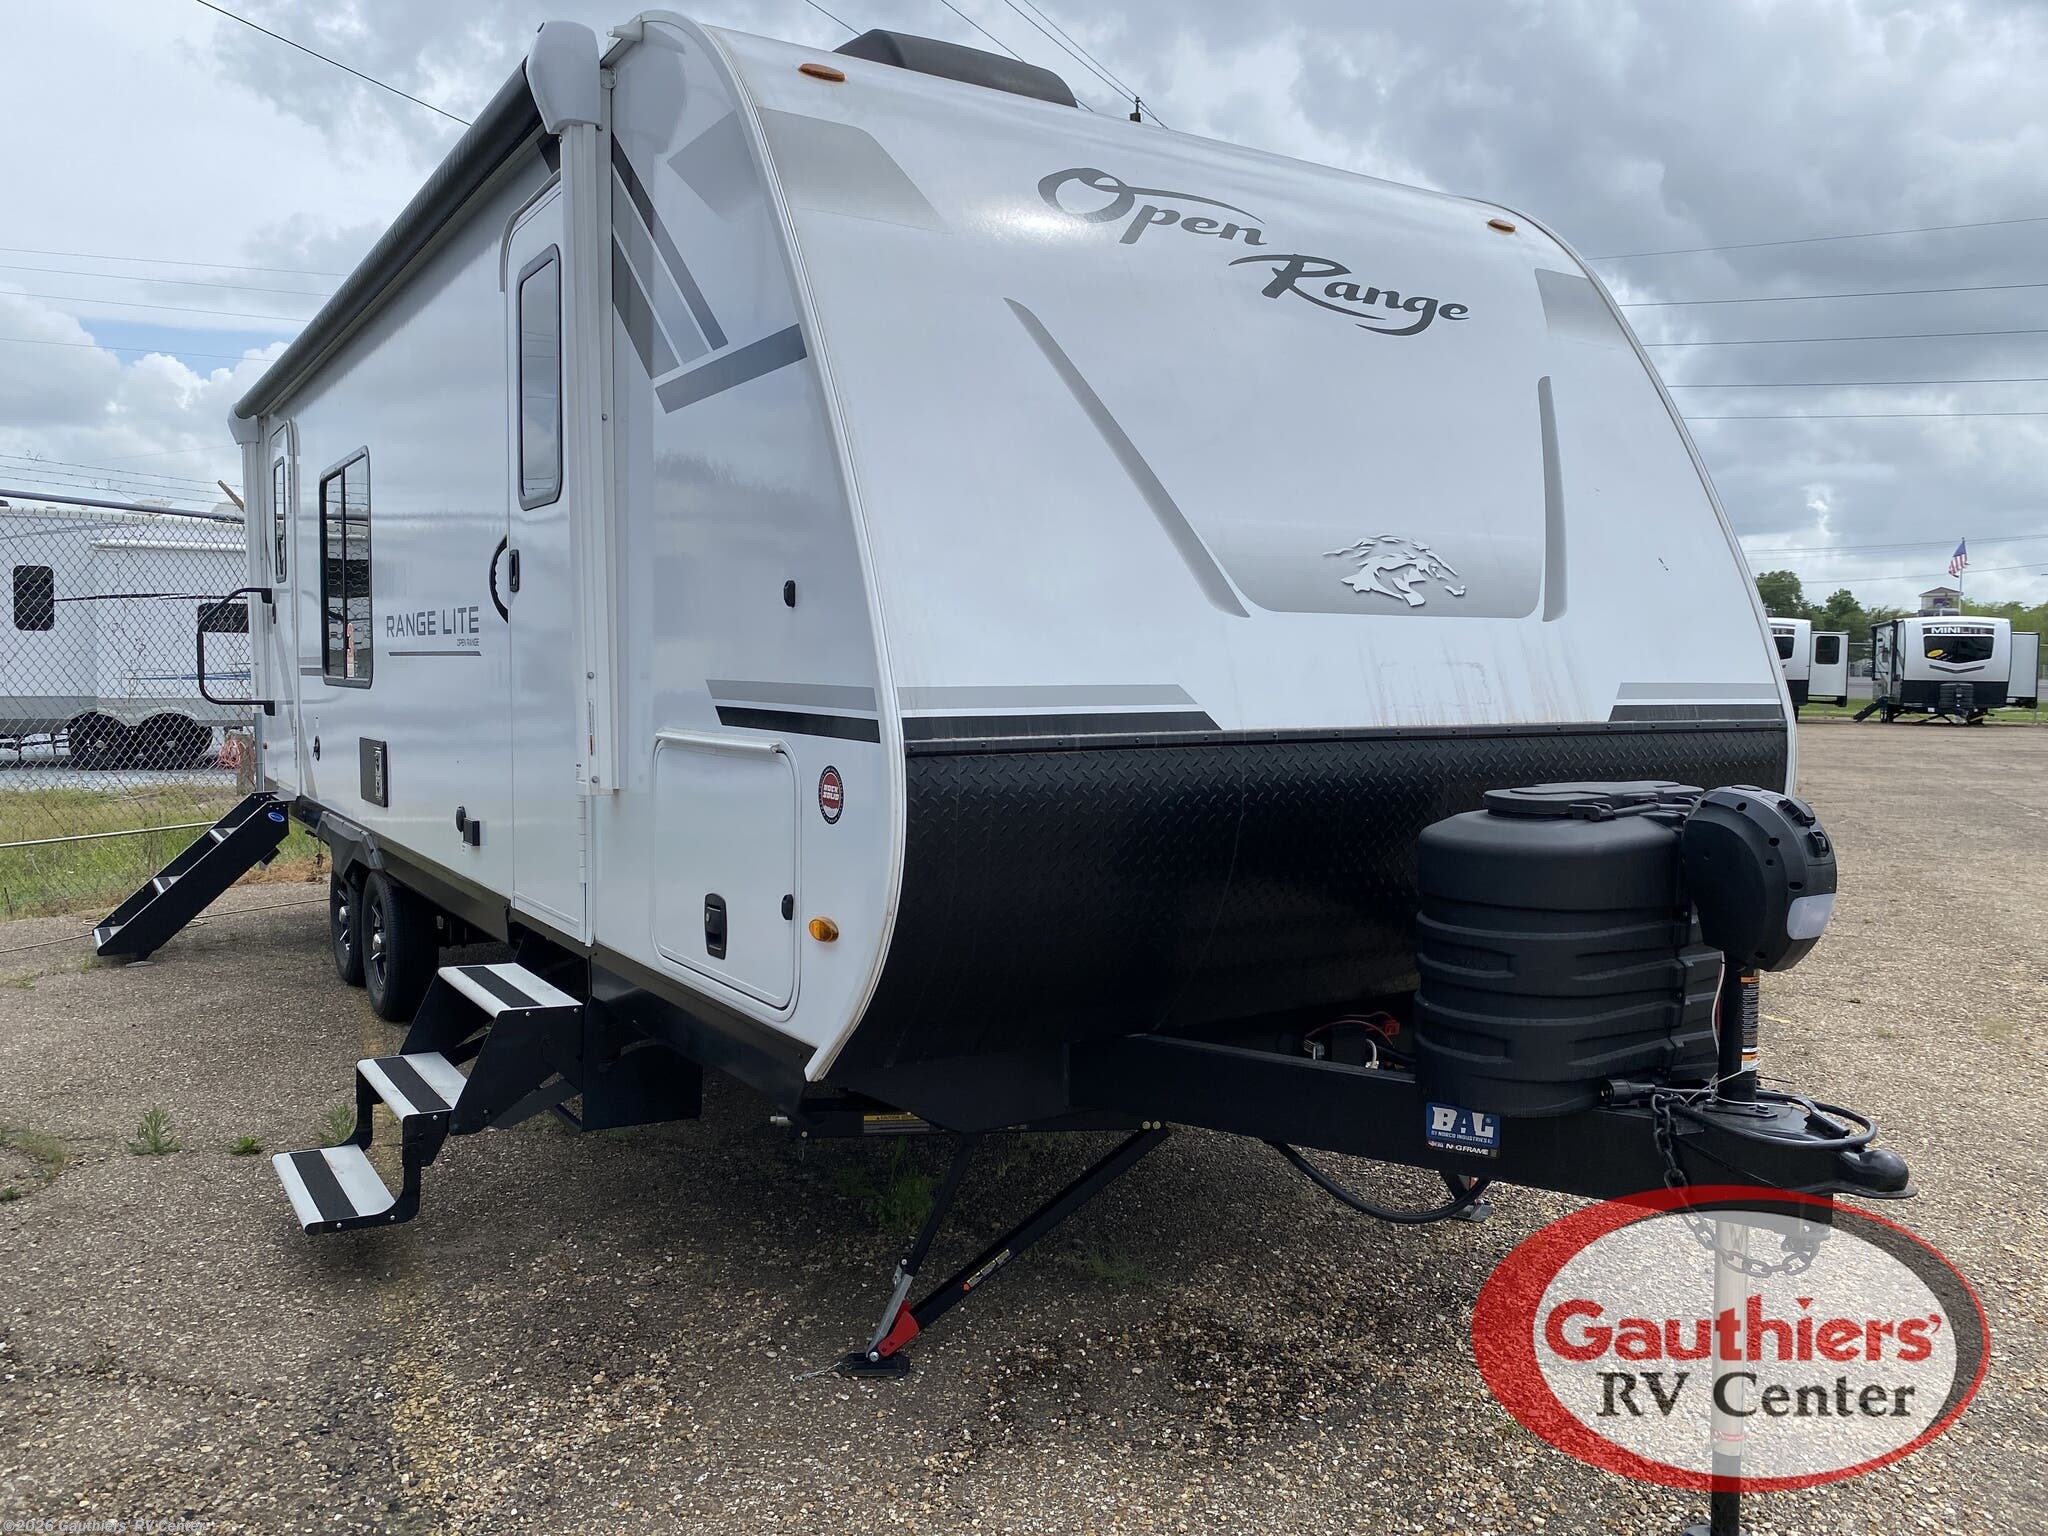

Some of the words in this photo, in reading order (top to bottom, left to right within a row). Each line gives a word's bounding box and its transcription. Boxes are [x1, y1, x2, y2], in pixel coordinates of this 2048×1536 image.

[1037, 167, 1268, 245] Open
[1228, 253, 1470, 337] Range
[386, 611, 437, 638] RANGE
[442, 605, 480, 635] LITE
